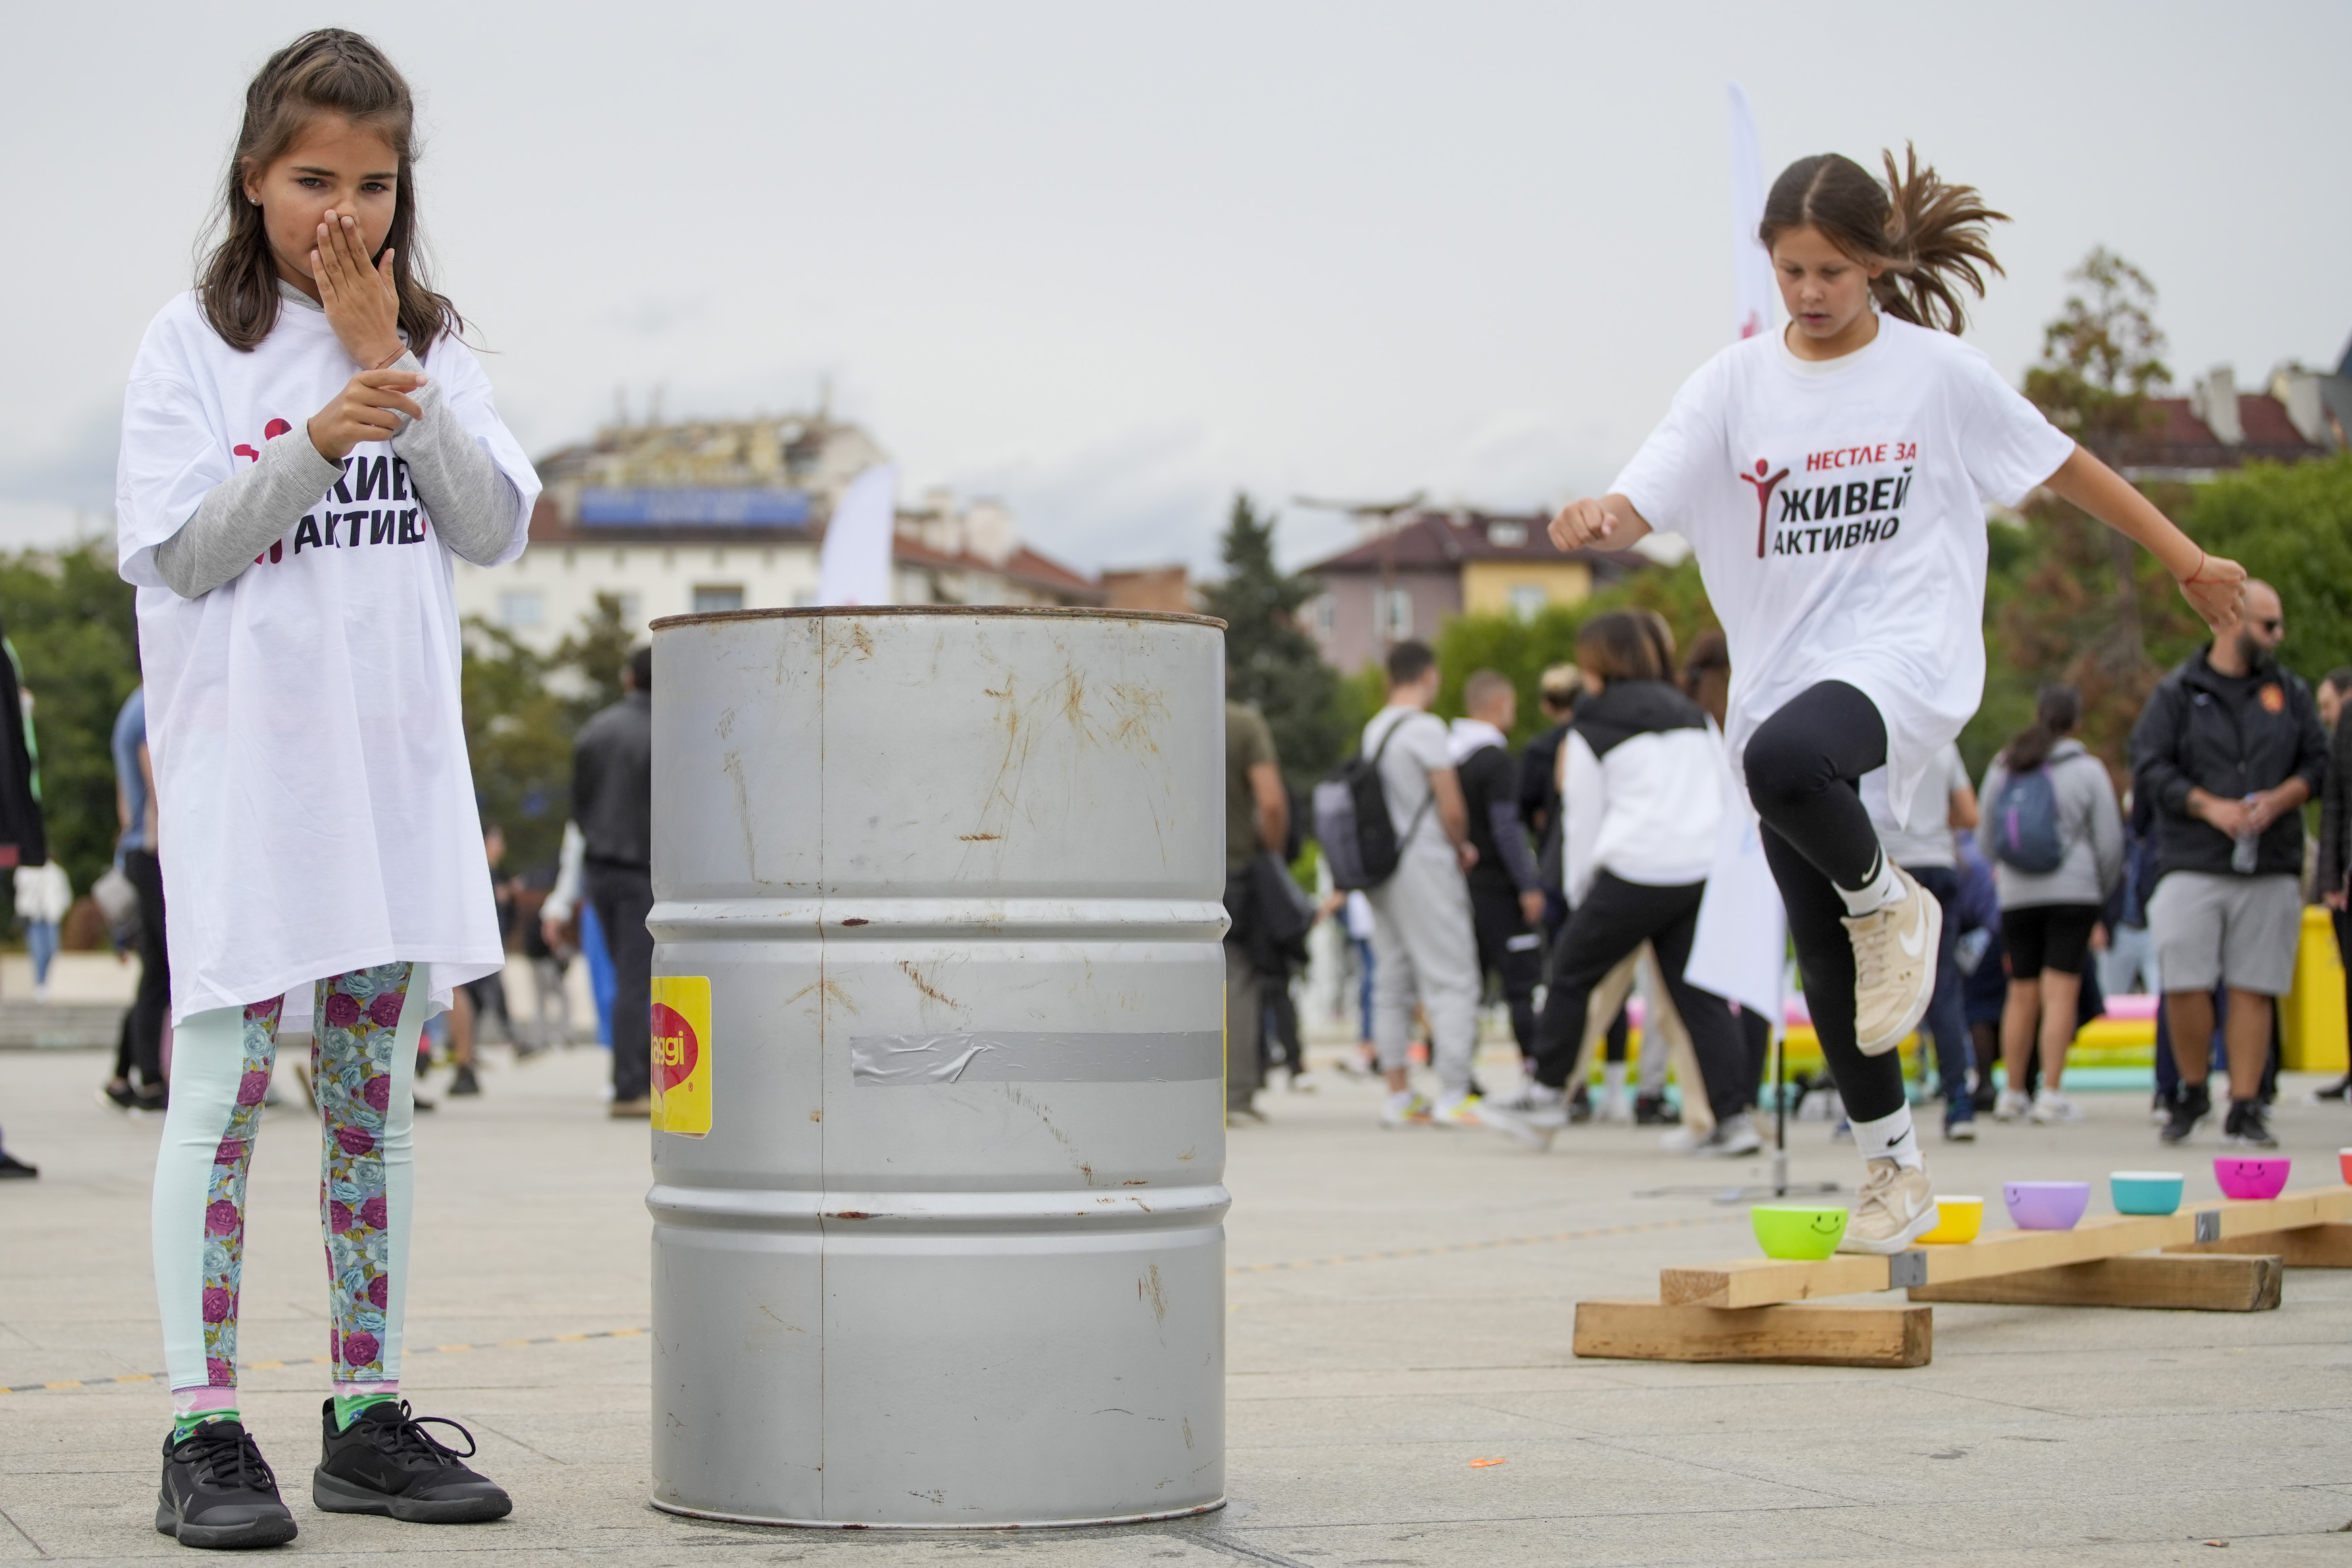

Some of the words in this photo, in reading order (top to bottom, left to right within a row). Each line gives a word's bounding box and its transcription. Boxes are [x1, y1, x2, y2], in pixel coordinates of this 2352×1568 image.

[1807, 444, 1887, 471] НЕСТЛЕ
[1894, 443, 1917, 460] ЗА
[1780, 466, 1913, 522] ЖИВЕЙ
[1772, 518, 1899, 555] АКТИВНО
[651, 1031, 684, 1066] aggi
